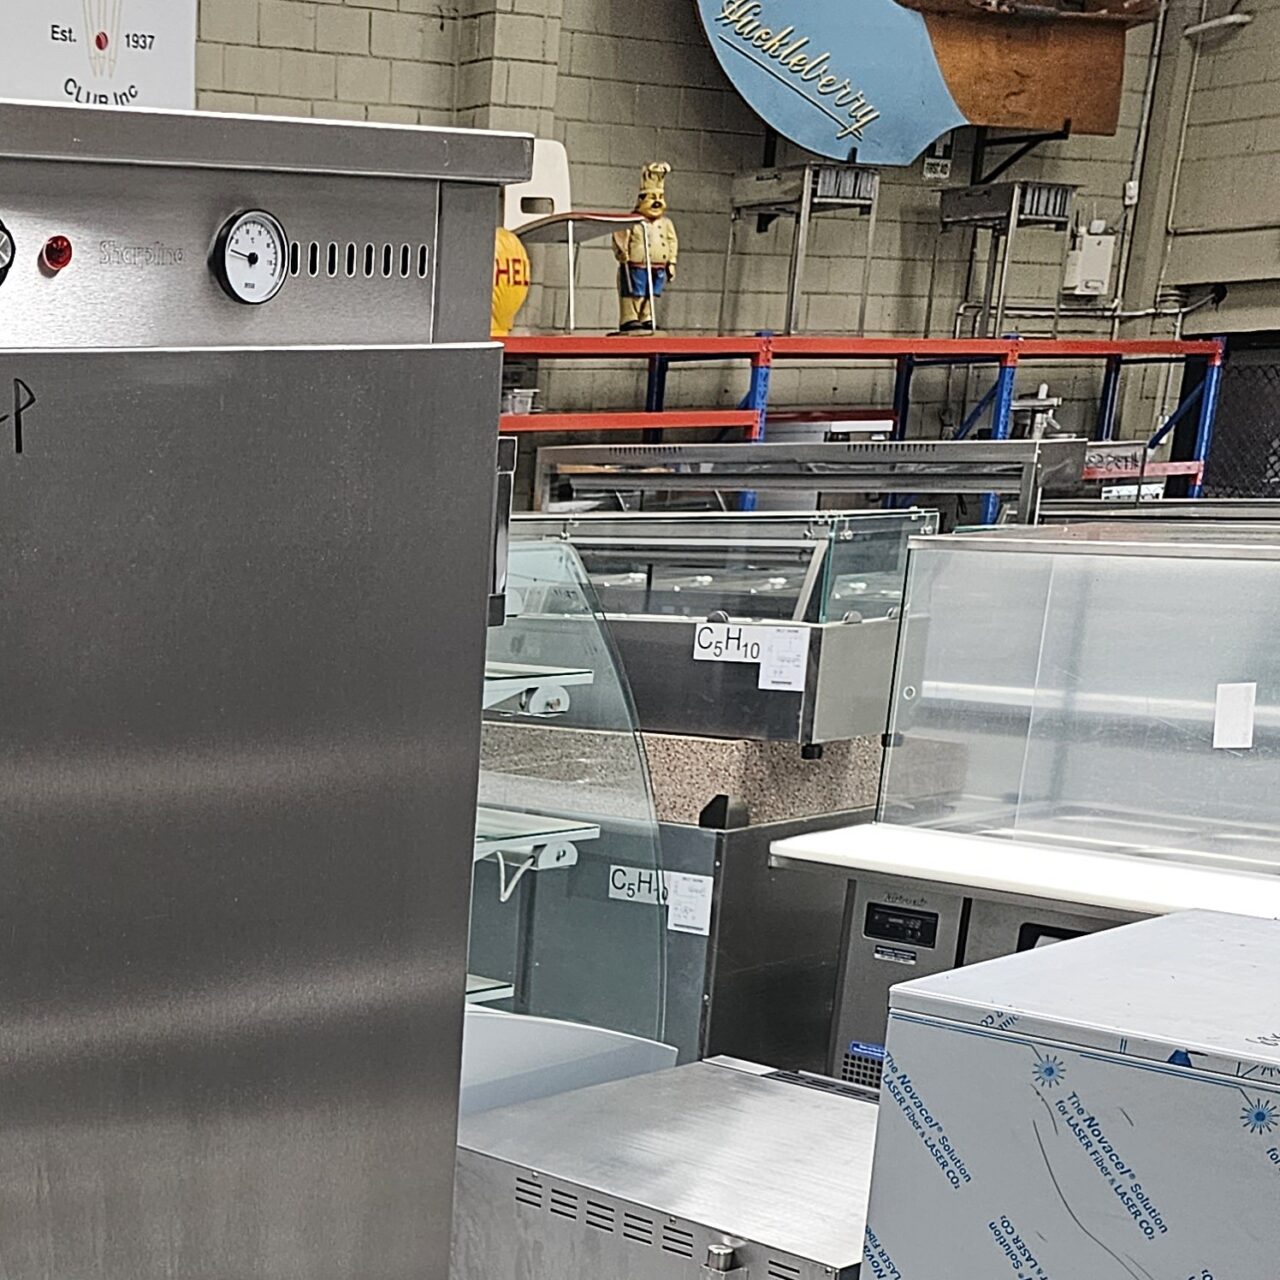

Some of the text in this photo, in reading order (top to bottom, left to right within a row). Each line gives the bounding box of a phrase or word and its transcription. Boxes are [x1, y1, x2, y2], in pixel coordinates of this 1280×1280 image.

[51, 24, 155, 50] Est. 1937
[882, 1073, 905, 1106] LASER
[902, 1104, 922, 1130] Fiber
[923, 1136, 948, 1170] LASER
[938, 1135, 971, 1182] Solution
[1054, 1099, 1069, 1115] for
[1065, 1115, 1093, 1150] LASER
[1089, 1149, 1112, 1176] Fiber
[1113, 1184, 1142, 1220] LASER
[1067, 1090, 1084, 1115] The
[1130, 1183, 1167, 1233] Solution
[862, 1244, 886, 1279] Nova
[877, 1248, 901, 1280] LASER
[988, 1221, 1022, 1269] Solution
[1011, 1234, 1037, 1268] LASER
